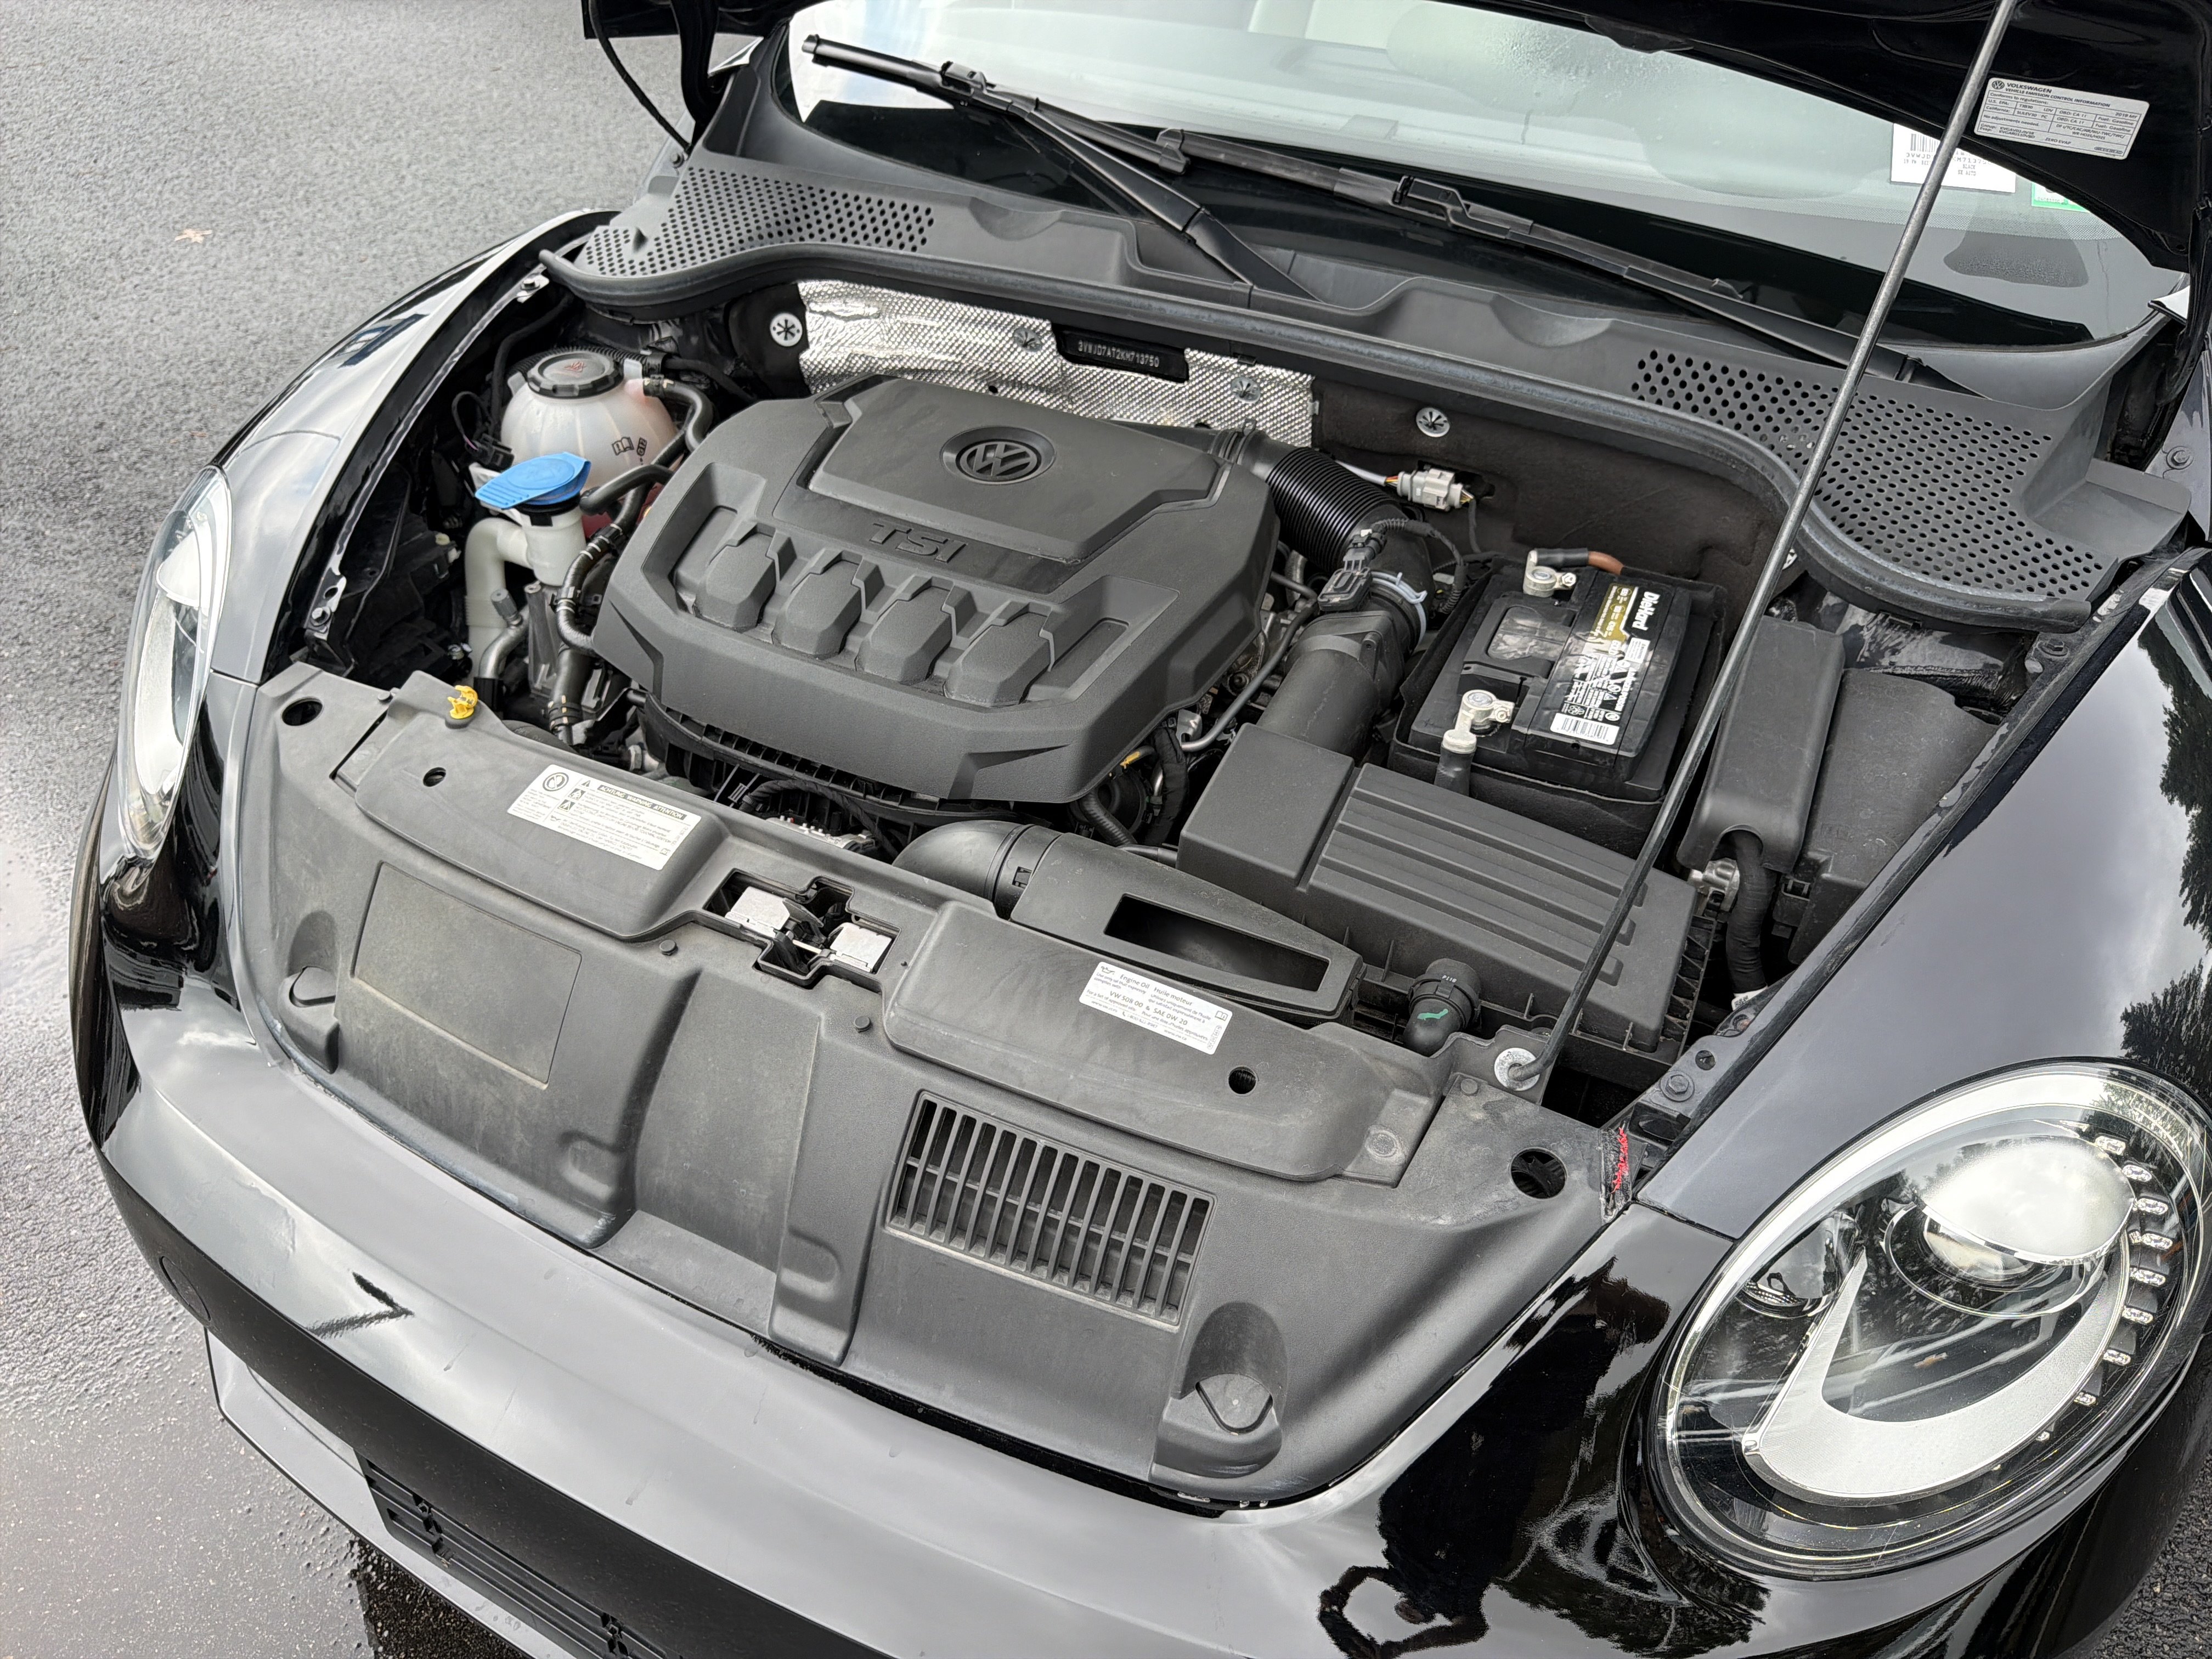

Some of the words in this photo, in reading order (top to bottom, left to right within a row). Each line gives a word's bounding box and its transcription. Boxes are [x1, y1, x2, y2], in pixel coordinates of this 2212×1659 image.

[2007, 83, 2052, 93] VOLKSWAGEN
[2074, 99, 2111, 108] INFORMATION
[869, 522, 968, 563] TSI
[1632, 591, 1661, 631] DieHard
[600, 786, 626, 798] ACHTUNG
[627, 795, 653, 808] WARNING
[653, 805, 683, 819] ATTENTION
[1120, 974, 1140, 985] Engine
[1110, 991, 1122, 999] VW
[1121, 995, 1134, 1004] 508
[1153, 1008, 1166, 1017] SAE
[1154, 987, 1170, 997] Huile
[1170, 994, 1193, 1006] moteur
